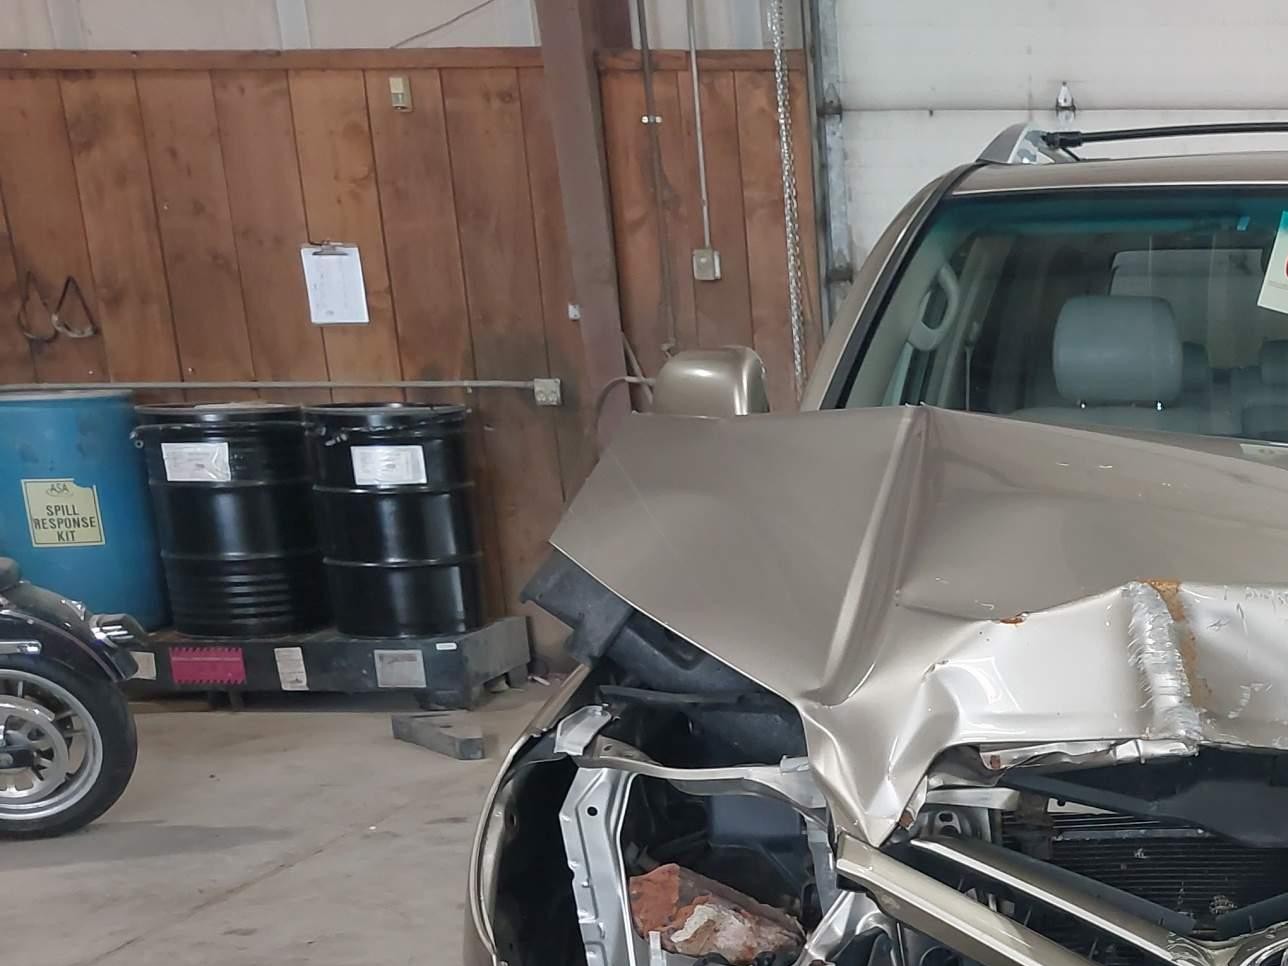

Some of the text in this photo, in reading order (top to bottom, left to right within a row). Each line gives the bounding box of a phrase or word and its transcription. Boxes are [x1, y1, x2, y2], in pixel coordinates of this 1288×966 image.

[50, 483, 70, 494] ASA
[46, 504, 80, 517] SPILL
[33, 516, 97, 530] RESPONSE
[57, 530, 76, 542] KIT
